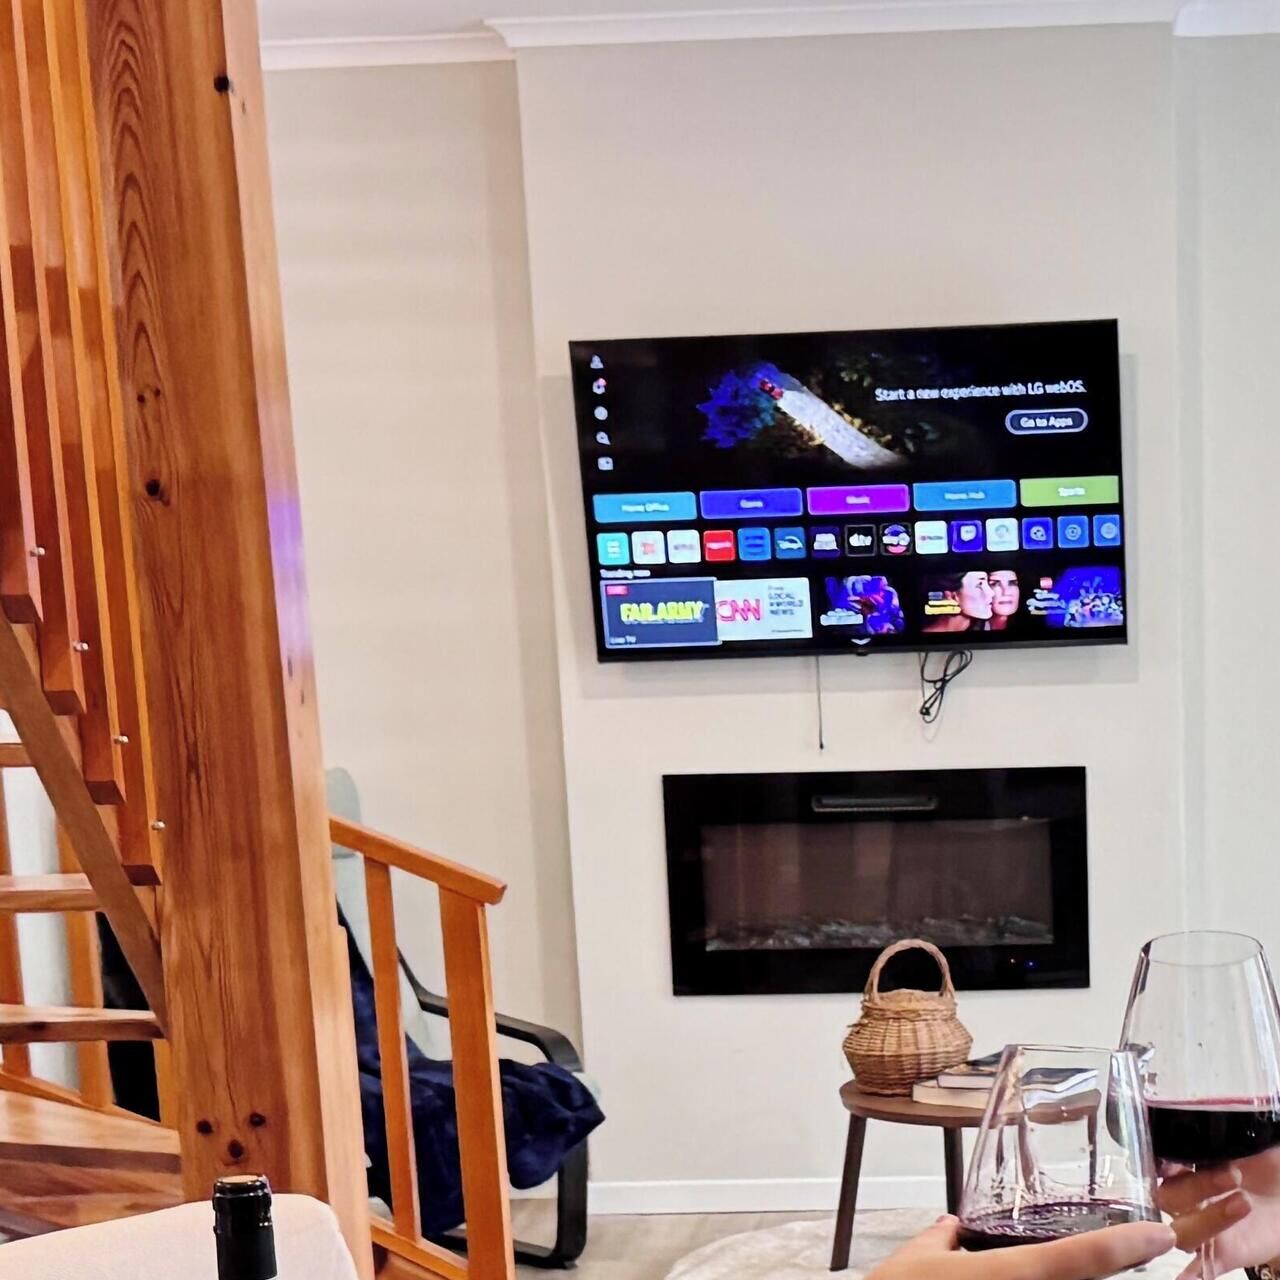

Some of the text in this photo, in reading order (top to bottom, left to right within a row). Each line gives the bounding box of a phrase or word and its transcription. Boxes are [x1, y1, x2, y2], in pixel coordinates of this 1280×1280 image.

[875, 387, 906, 401] Start
[907, 389, 916, 399] a
[916, 388, 940, 399] new
[941, 385, 1000, 400] experience
[1002, 382, 1027, 396] with
[1027, 382, 1044, 394] LG
[1020, 416, 1073, 428] Go to Apps
[718, 598, 761, 622] CNN
